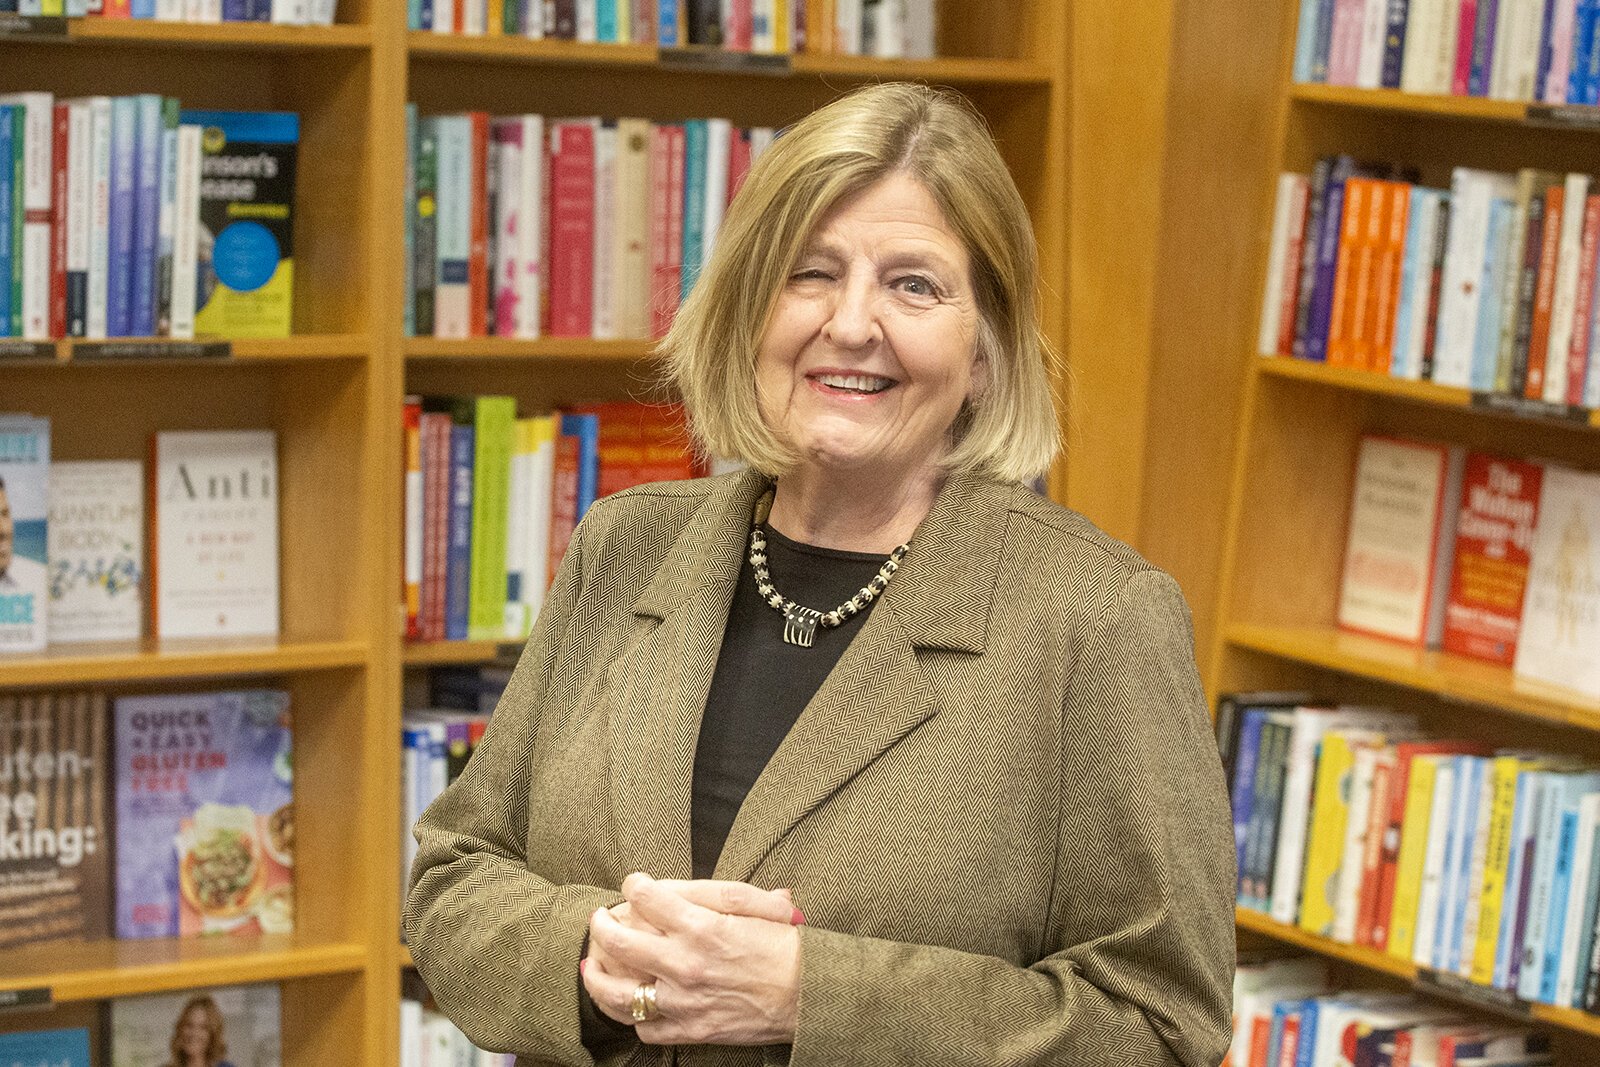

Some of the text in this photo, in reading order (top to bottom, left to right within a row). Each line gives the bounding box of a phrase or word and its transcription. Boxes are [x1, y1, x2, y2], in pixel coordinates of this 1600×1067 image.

[201, 152, 279, 179] nson's
[201, 179, 257, 200] ease
[166, 458, 270, 501] Anti
[49, 502, 138, 525] UANTUM
[131, 709, 211, 731] QUICK
[0, 747, 93, 782] uten-
[131, 752, 227, 772] GLUTEN
[0, 820, 97, 867] king:
